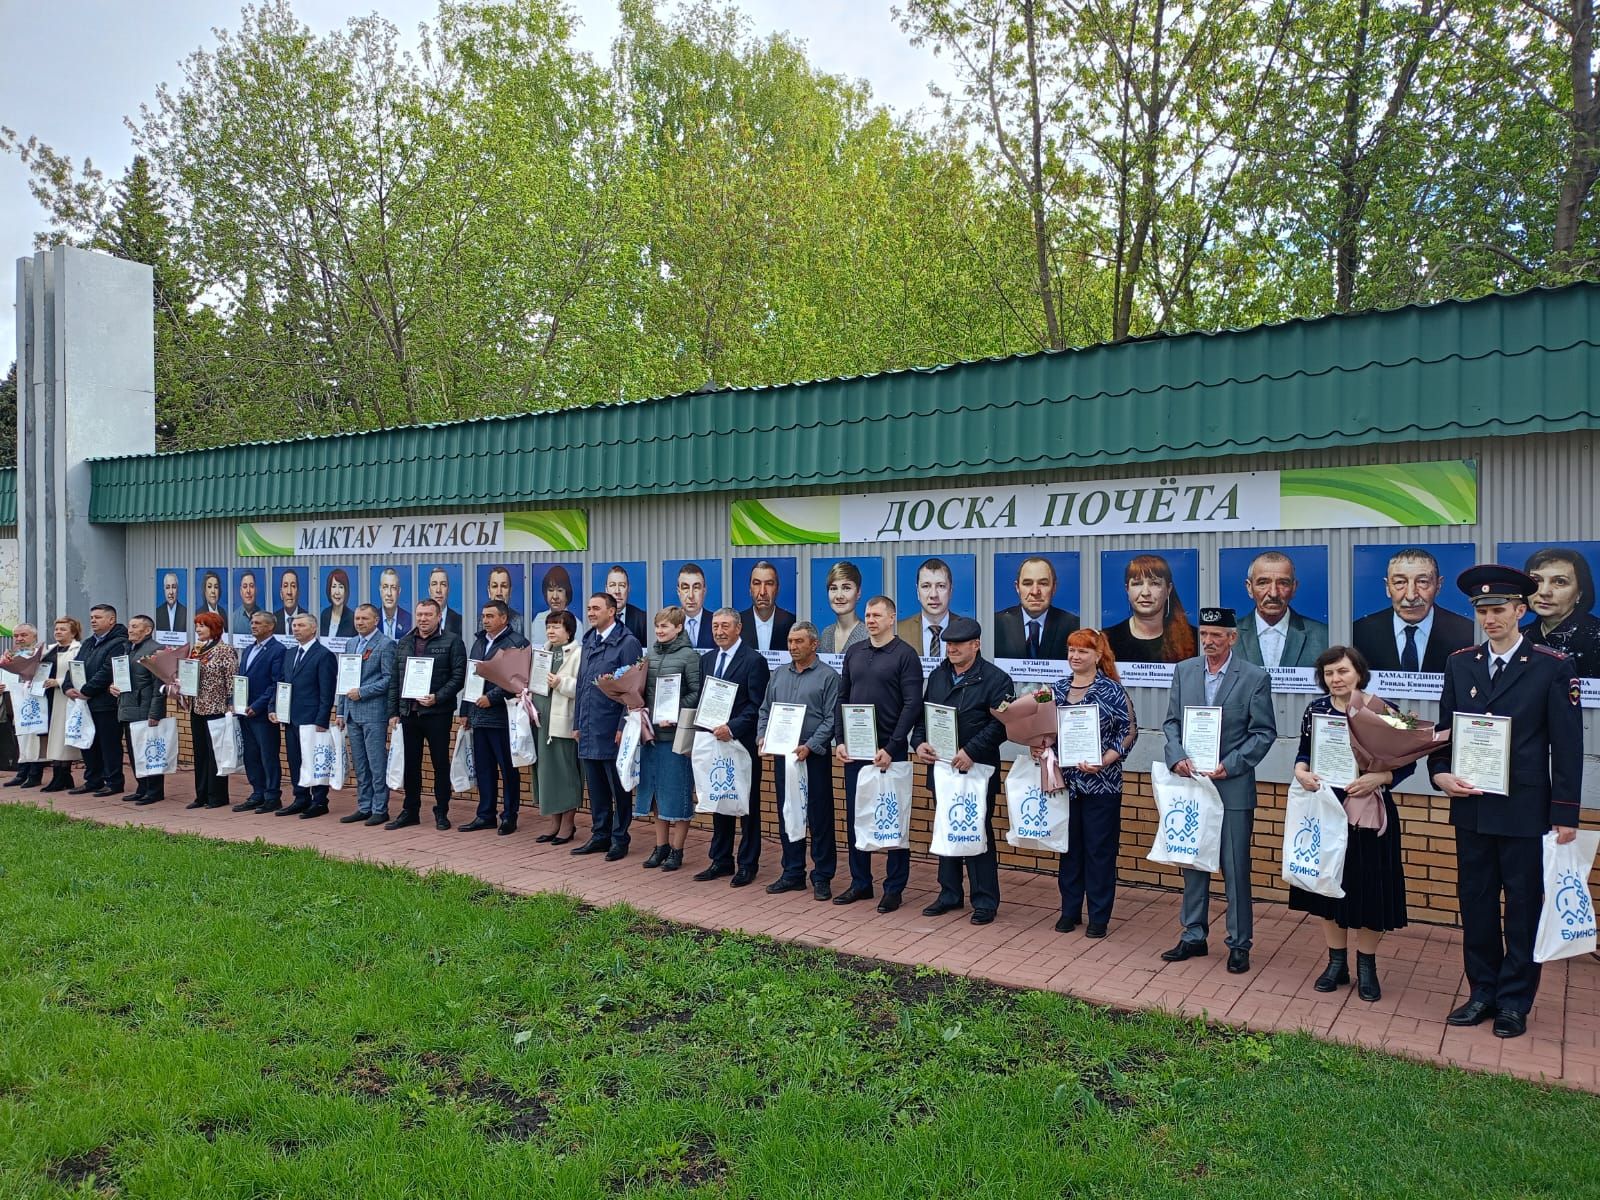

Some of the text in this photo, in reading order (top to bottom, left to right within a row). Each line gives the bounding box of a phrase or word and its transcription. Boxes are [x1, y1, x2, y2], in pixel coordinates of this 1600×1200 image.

[876, 477, 1240, 541] ДОСКА ПОЧЁТА
[299, 521, 500, 549] МАКТАУ ТАКТАСЫ
[709, 793, 739, 801] Буинск
[873, 832, 902, 840] Буинск
[1018, 827, 1051, 837] Буинск
[947, 833, 981, 842] Буинск
